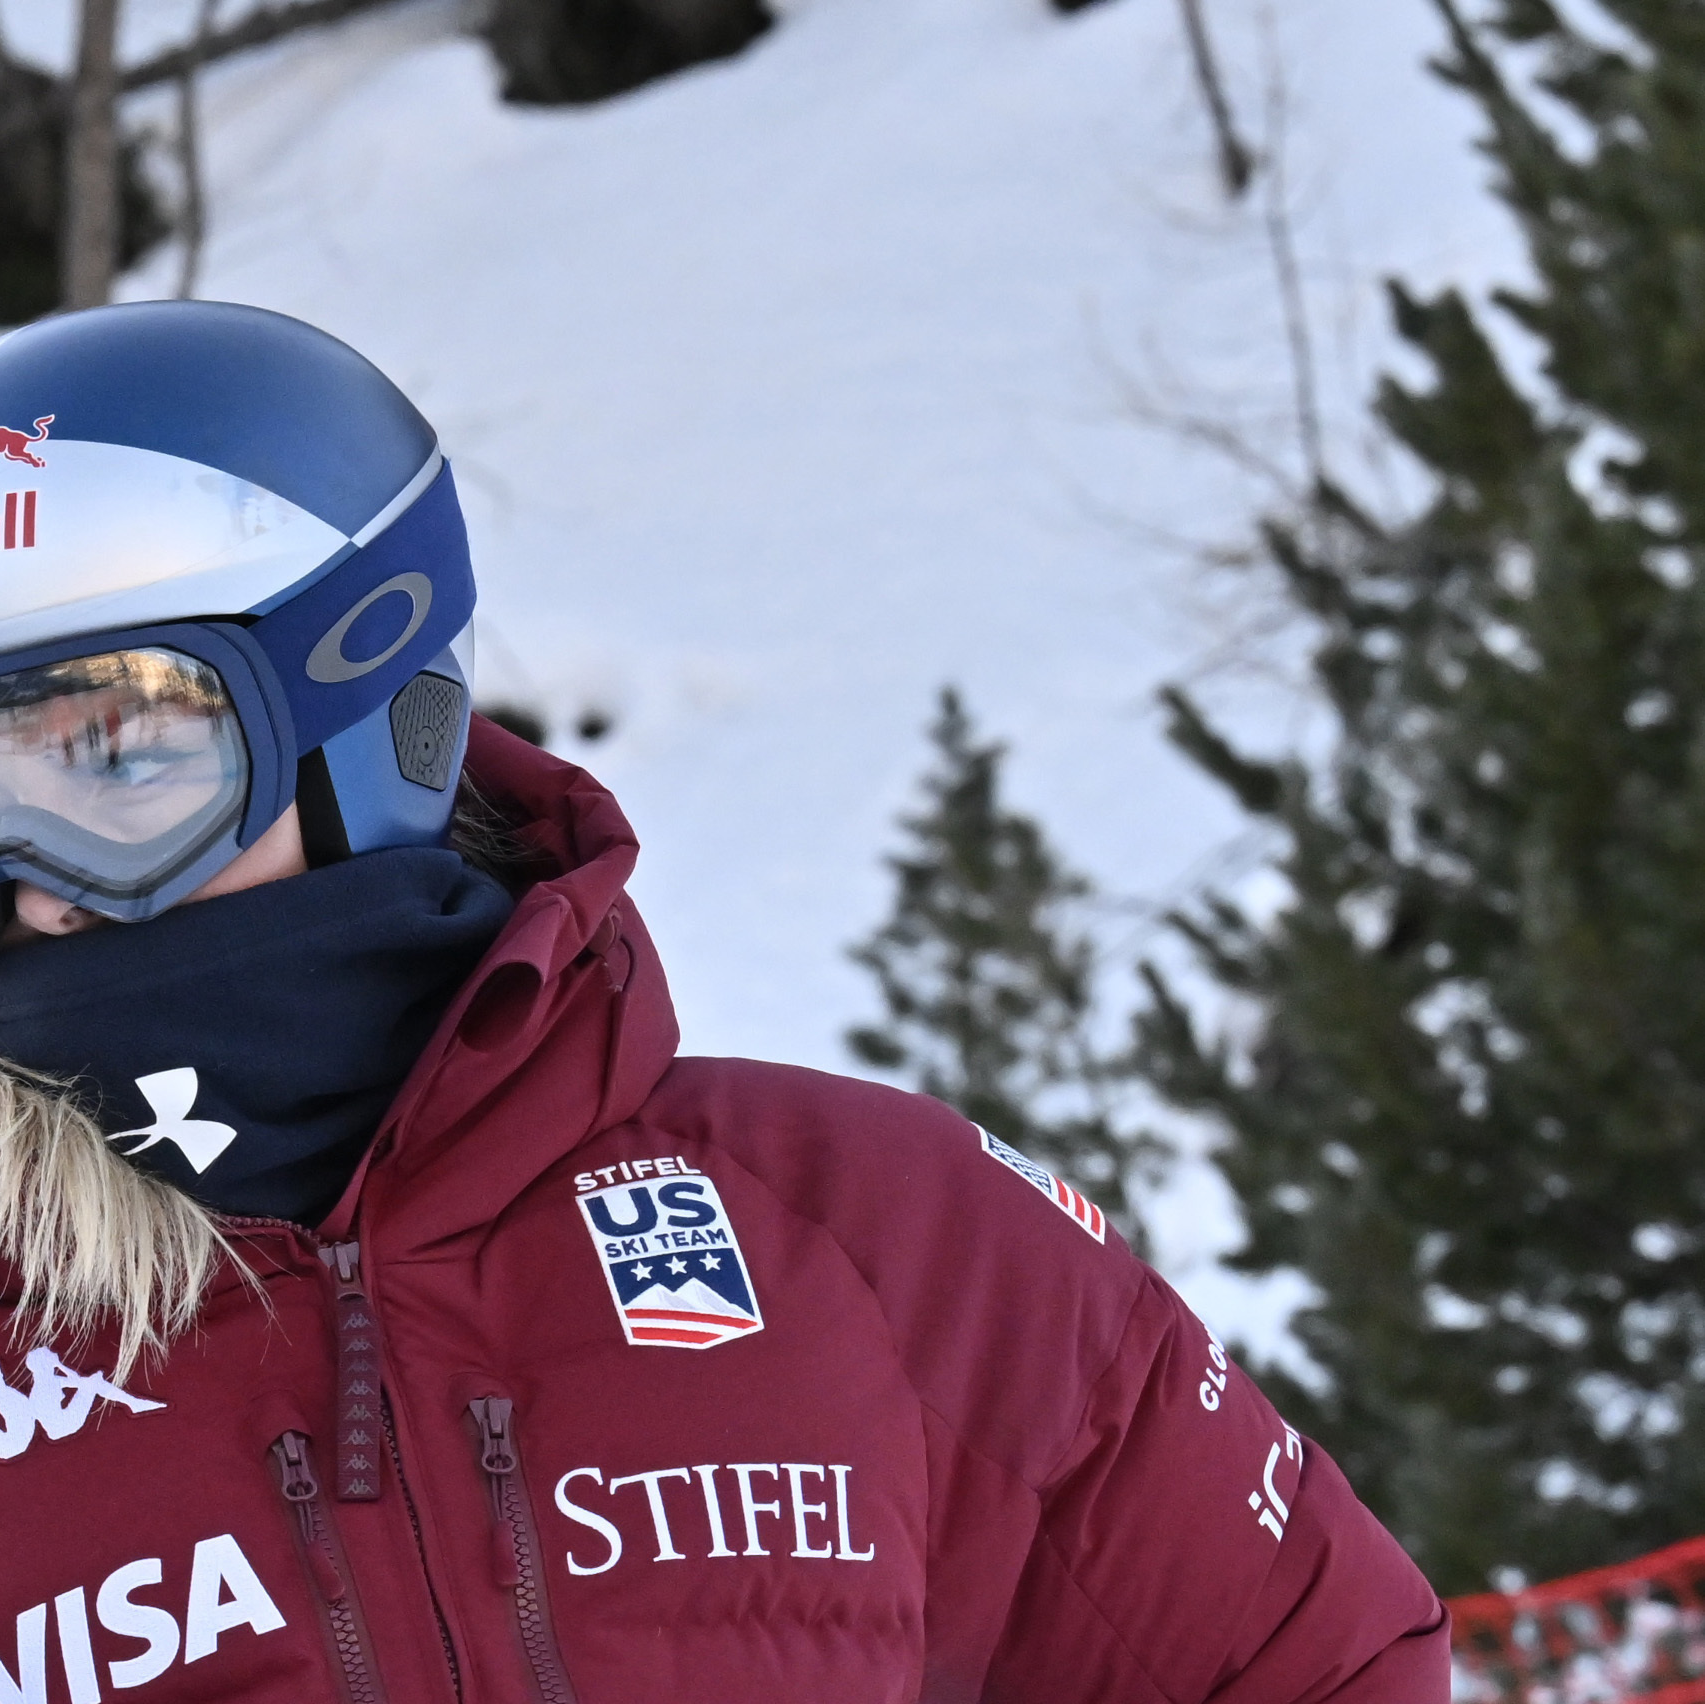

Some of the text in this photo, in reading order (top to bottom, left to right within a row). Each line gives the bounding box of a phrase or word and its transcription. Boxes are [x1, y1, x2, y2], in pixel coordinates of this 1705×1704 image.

[574, 1156, 701, 1192] STIFEL
[583, 1182, 718, 1238] US
[605, 1227, 729, 1259] SKI TEAM
[554, 1463, 875, 1576] STIFEL
